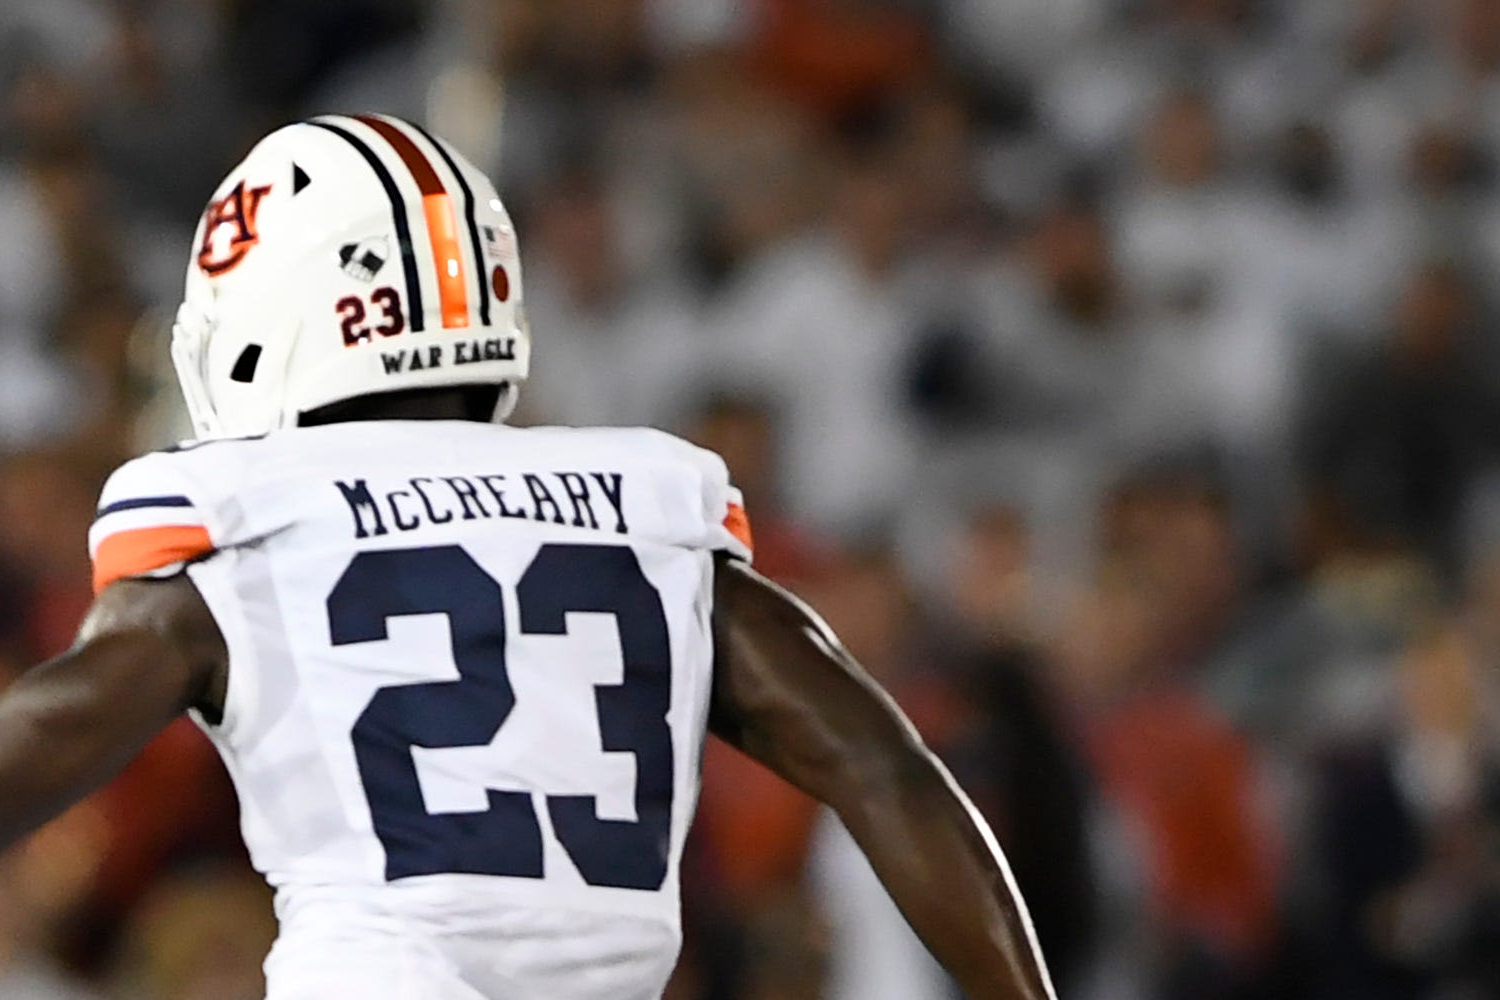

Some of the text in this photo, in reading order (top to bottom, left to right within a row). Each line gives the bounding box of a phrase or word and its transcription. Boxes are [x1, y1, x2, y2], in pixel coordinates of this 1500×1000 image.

[335, 286, 405, 347] 23
[380, 336, 516, 375] WAR EAGLE
[333, 471, 629, 540] McCREARY
[326, 543, 674, 892] 23
